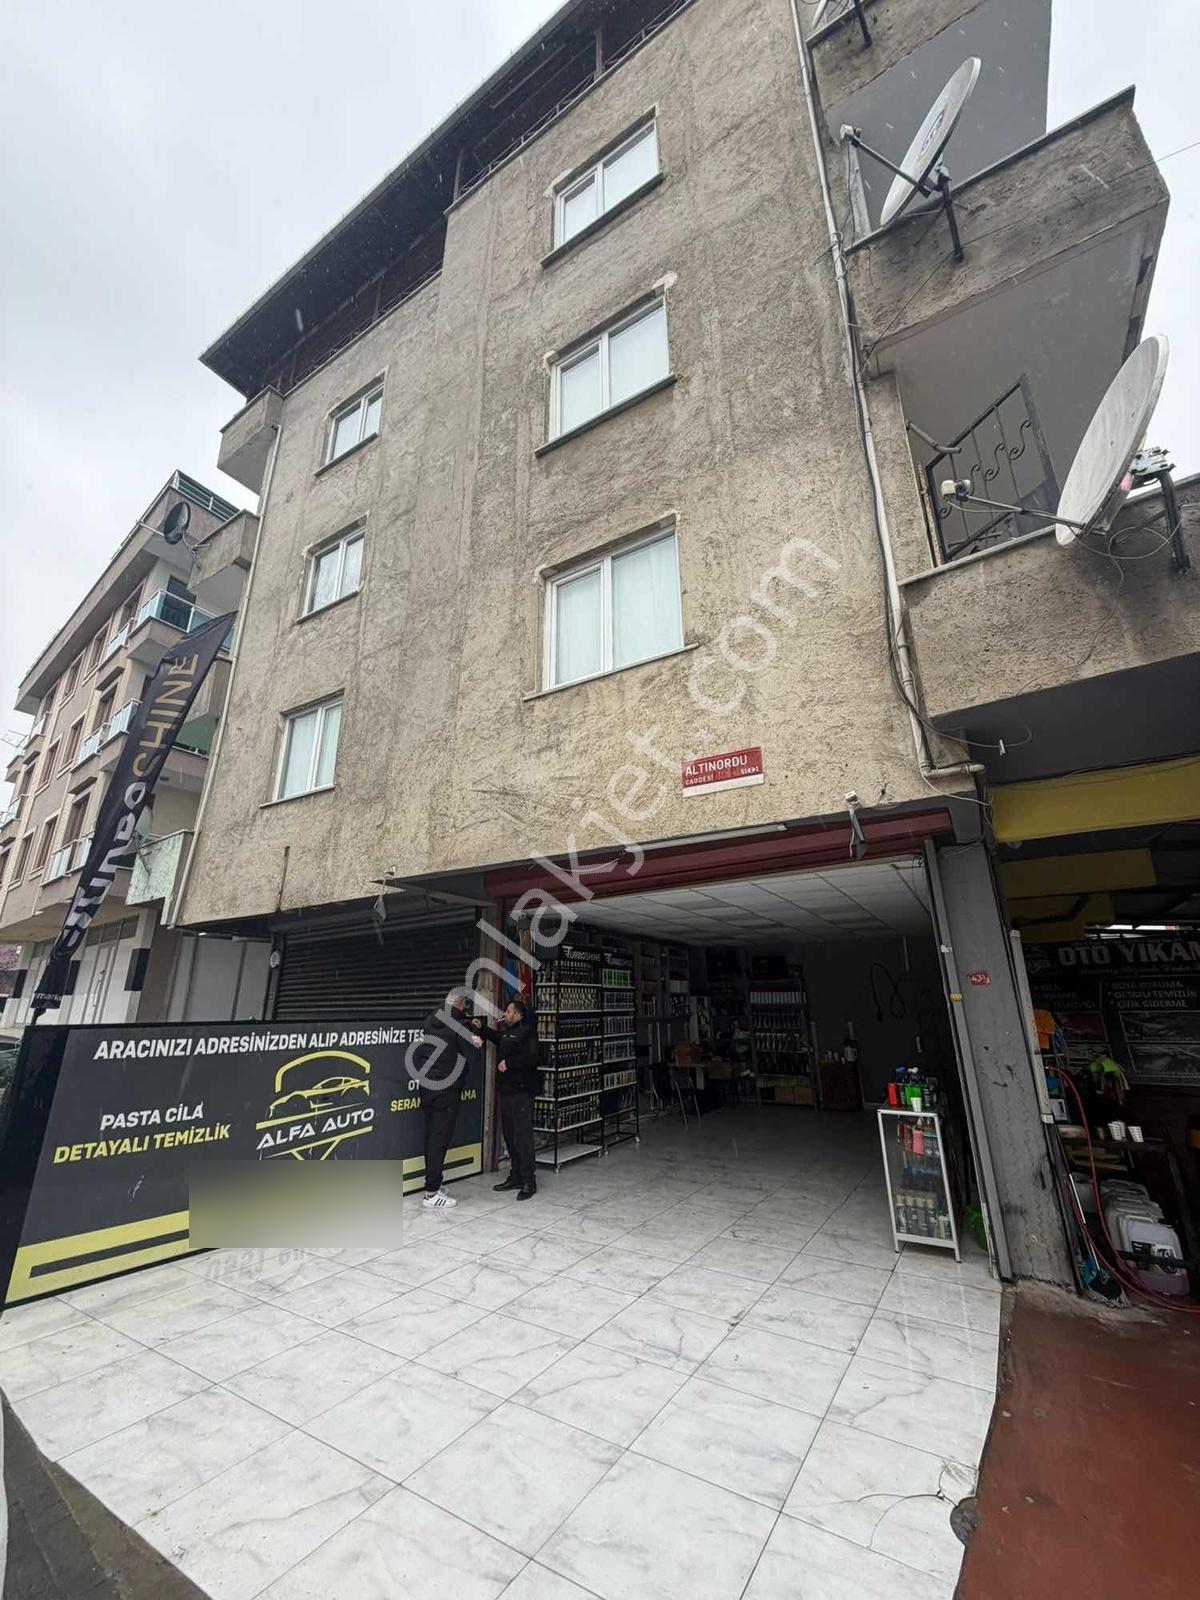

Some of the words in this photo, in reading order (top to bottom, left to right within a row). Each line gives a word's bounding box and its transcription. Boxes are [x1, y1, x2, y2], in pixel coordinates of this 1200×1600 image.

[685, 755, 748, 776] ALTINORDU
[1058, 946, 1112, 966] OTO
[93, 1038, 193, 1060] ARACINIZI
[194, 1031, 307, 1056] ADRESİNİZDEN
[308, 1031, 335, 1049] ALIP
[339, 1026, 406, 1047] ADRESİNİZE
[100, 1108, 161, 1131] PASTA
[165, 1102, 204, 1124] CİLA
[256, 1123, 316, 1151] ALFA
[321, 1107, 375, 1134] AUTO
[53, 1136, 150, 1164] DETAYALI
[153, 1122, 231, 1149] TEMİZLİK
